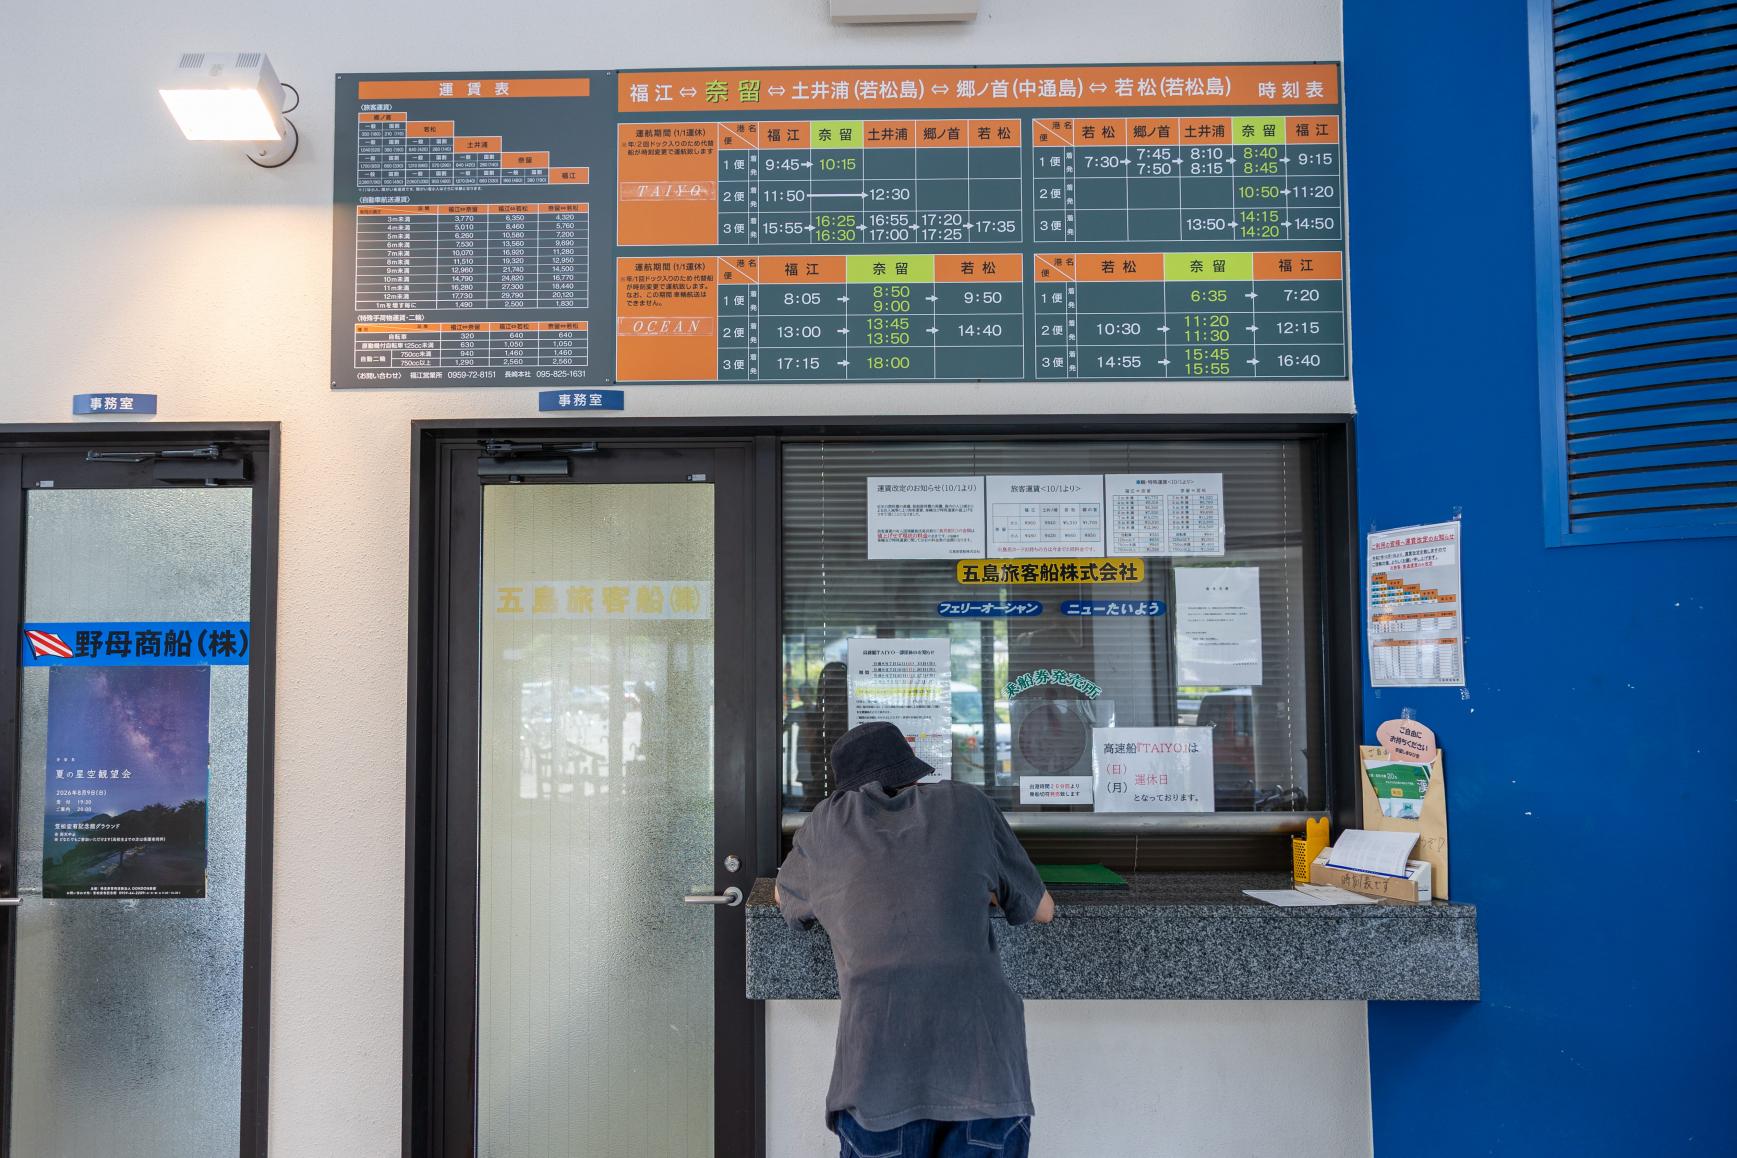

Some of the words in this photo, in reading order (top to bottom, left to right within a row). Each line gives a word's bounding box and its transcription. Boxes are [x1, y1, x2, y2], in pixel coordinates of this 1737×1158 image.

[439, 81, 510, 96] 運賃表
[630, 83, 672, 102] 福江
[704, 79, 761, 104] 奈留
[791, 79, 925, 100] 土井浦(若松島)
[957, 78, 1083, 99] 郷ノ首(中通島)
[1114, 76, 1232, 97] 若松(若松島)
[1258, 81, 1324, 98] 時刻表
[768, 128, 800, 142] 福江
[818, 128, 852, 141] 奈留
[867, 127, 907, 141] 土井浦
[923, 126, 960, 141] 郷ノ首
[978, 127, 1011, 140] 若松
[1082, 125, 1115, 139] 若松
[1133, 125, 1170, 138] 郷ノ首
[1185, 125, 1224, 138] 土井浦
[1241, 124, 1276, 137] 奈留
[1295, 123, 1328, 136] 福江
[724, 136, 732, 145] 便
[1136, 148, 1171, 160] 7:45
[1190, 148, 1222, 159] 8:10
[1243, 147, 1278, 159] 8:40
[1298, 153, 1332, 165] 9:15
[723, 159, 745, 170] 1便
[765, 158, 800, 171] 9:45
[819, 158, 856, 170] 10:15
[1040, 156, 1061, 166] 1便
[1084, 156, 1119, 168] 7:30
[1244, 162, 1278, 174] 8:45
[1136, 162, 1171, 175] 7:50
[1190, 163, 1223, 174] 8:15
[723, 191, 745, 201] 2便
[764, 189, 805, 202] 11:50
[869, 188, 910, 201] 12:30
[1040, 188, 1062, 199] 2便
[1239, 186, 1279, 198] 10:50
[1293, 186, 1333, 198] 11:20
[816, 215, 856, 226] 16:25
[869, 214, 909, 226] 16:55
[921, 214, 962, 226] 17:20
[1240, 210, 1279, 222] 14:15
[723, 223, 745, 233] 3便
[763, 222, 803, 234] 15:55
[975, 220, 1016, 232] 17:35
[1040, 220, 1062, 231] 3便
[1187, 218, 1225, 230] 13:50
[1294, 217, 1334, 229] 14:50
[816, 229, 856, 241] 16:30
[869, 228, 909, 240] 17:00
[921, 228, 962, 240] 17:25
[1241, 225, 1279, 238] 14:20
[784, 262, 819, 276] 福江
[873, 262, 908, 275] 奈留
[961, 261, 995, 274] 若松
[1101, 260, 1137, 273] 若松
[1190, 259, 1226, 272] 奈留
[1279, 259, 1313, 272] 福江
[724, 271, 732, 279] 便
[1041, 269, 1049, 277] 便
[873, 286, 911, 298] 8:50
[1041, 293, 1062, 303] 1便
[1191, 290, 1227, 302] 6:35
[1284, 290, 1320, 301] 7:20
[723, 295, 745, 306] 1便
[783, 293, 821, 305] 8:05
[963, 292, 1002, 304] 9:50
[873, 300, 911, 312] 9:00
[633, 320, 701, 332] OCEAN
[866, 318, 909, 330] 13:45
[1184, 315, 1229, 327] 11:20
[722, 327, 745, 339] 2便
[777, 326, 821, 338] 13:00
[958, 325, 1002, 337] 14:40
[1041, 325, 1063, 336] 2便
[1097, 322, 1141, 335] 10:30
[1276, 322, 1320, 334] 12:15
[866, 332, 909, 344] 13:50
[1184, 330, 1229, 342] 11:30
[1185, 349, 1229, 360] 15:45
[722, 359, 745, 371] 3便
[777, 358, 820, 369] 17:15
[867, 357, 910, 369] 18:00
[1041, 356, 1064, 368] 3便
[1097, 356, 1141, 368] 14:55
[1277, 354, 1320, 366] 16:40
[1185, 363, 1230, 375] 15:55
[90, 396, 134, 410] 事務室
[558, 393, 602, 407] 事務室
[961, 563, 1139, 583] 五島旅客船株式会社
[938, 602, 1039, 614] フェリーオーシャン
[1067, 602, 1160, 615] ニューたいよう
[75, 628, 248, 658] 野母商船(株)
[1004, 669, 1102, 700] 乗船券発売所
[1399, 727, 1423, 738] ご自由に
[55, 768, 132, 779] 夏の星空観望会
[1135, 774, 1168, 785] 運休日
